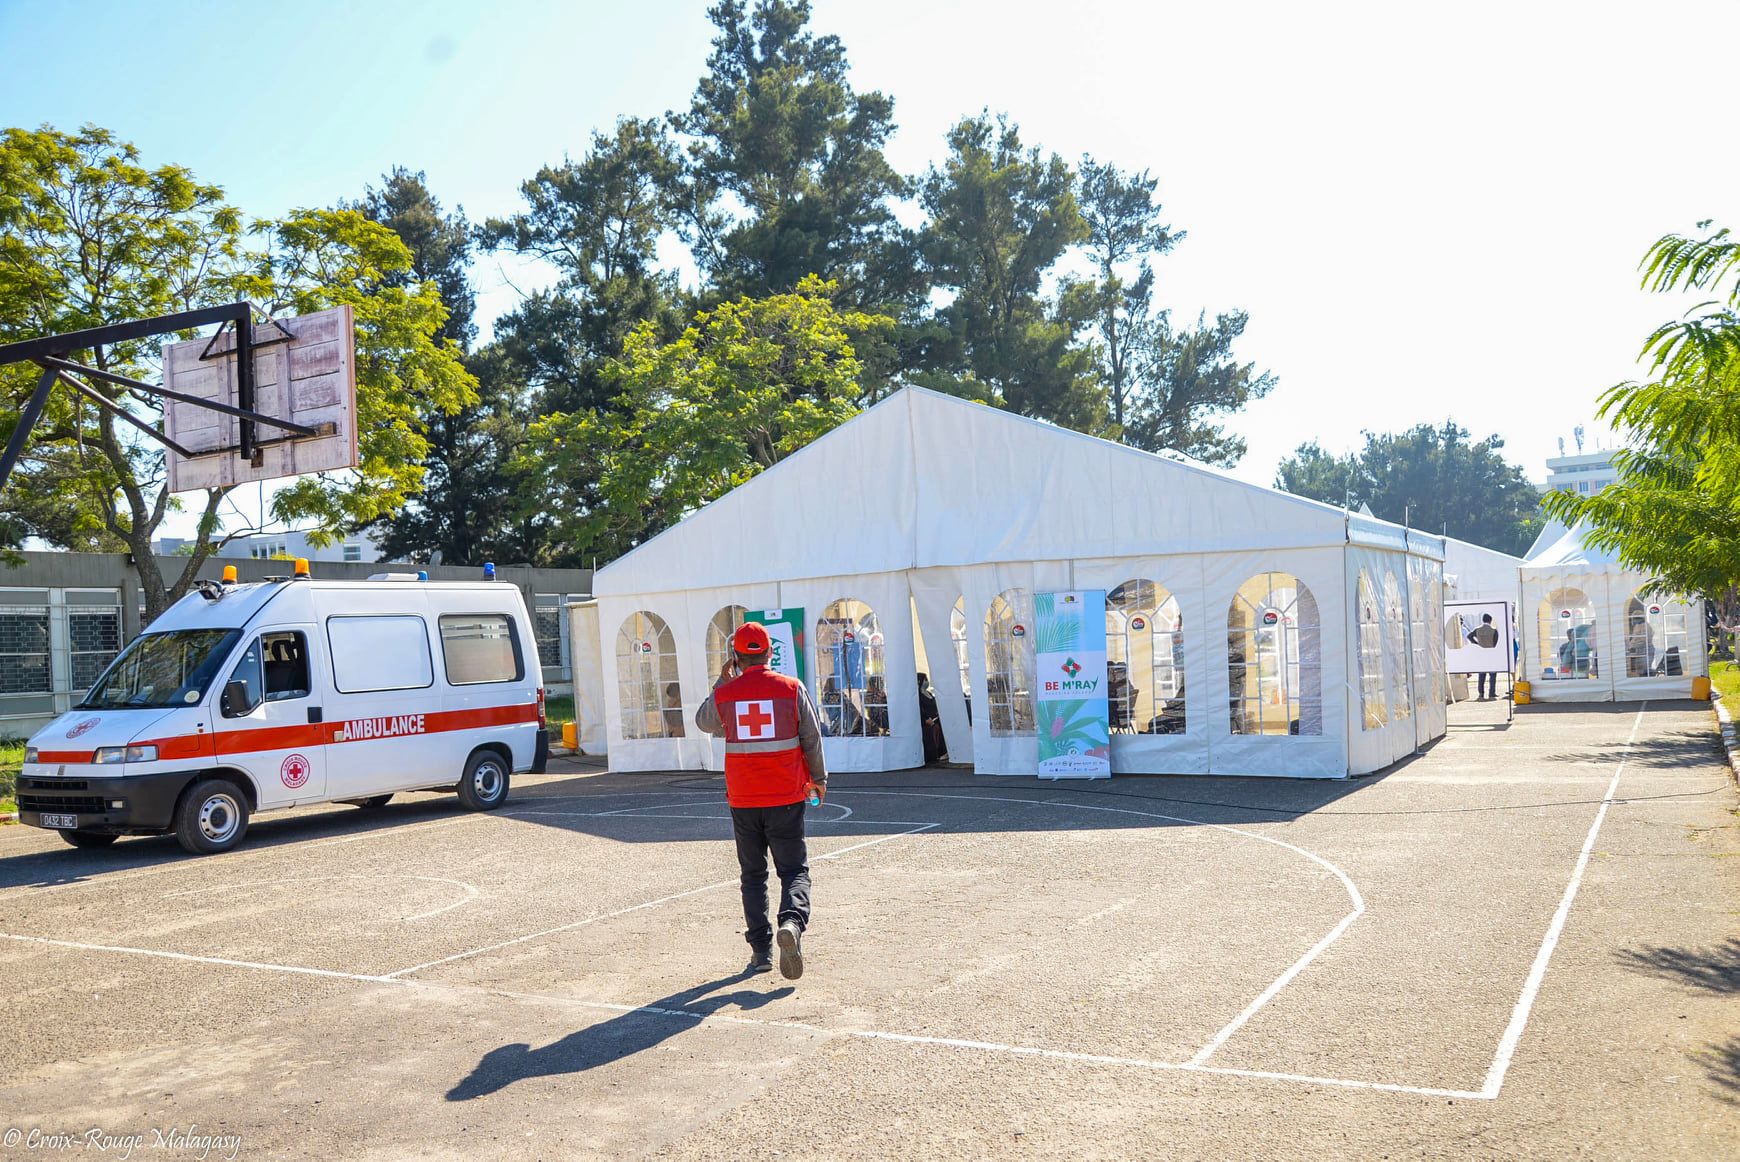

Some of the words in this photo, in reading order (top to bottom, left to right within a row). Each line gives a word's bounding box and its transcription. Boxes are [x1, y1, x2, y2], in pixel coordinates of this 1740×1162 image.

[1045, 681, 1059, 691] BE
[1062, 676, 1099, 692] M'RAY
[343, 714, 425, 740] AMBULANCE
